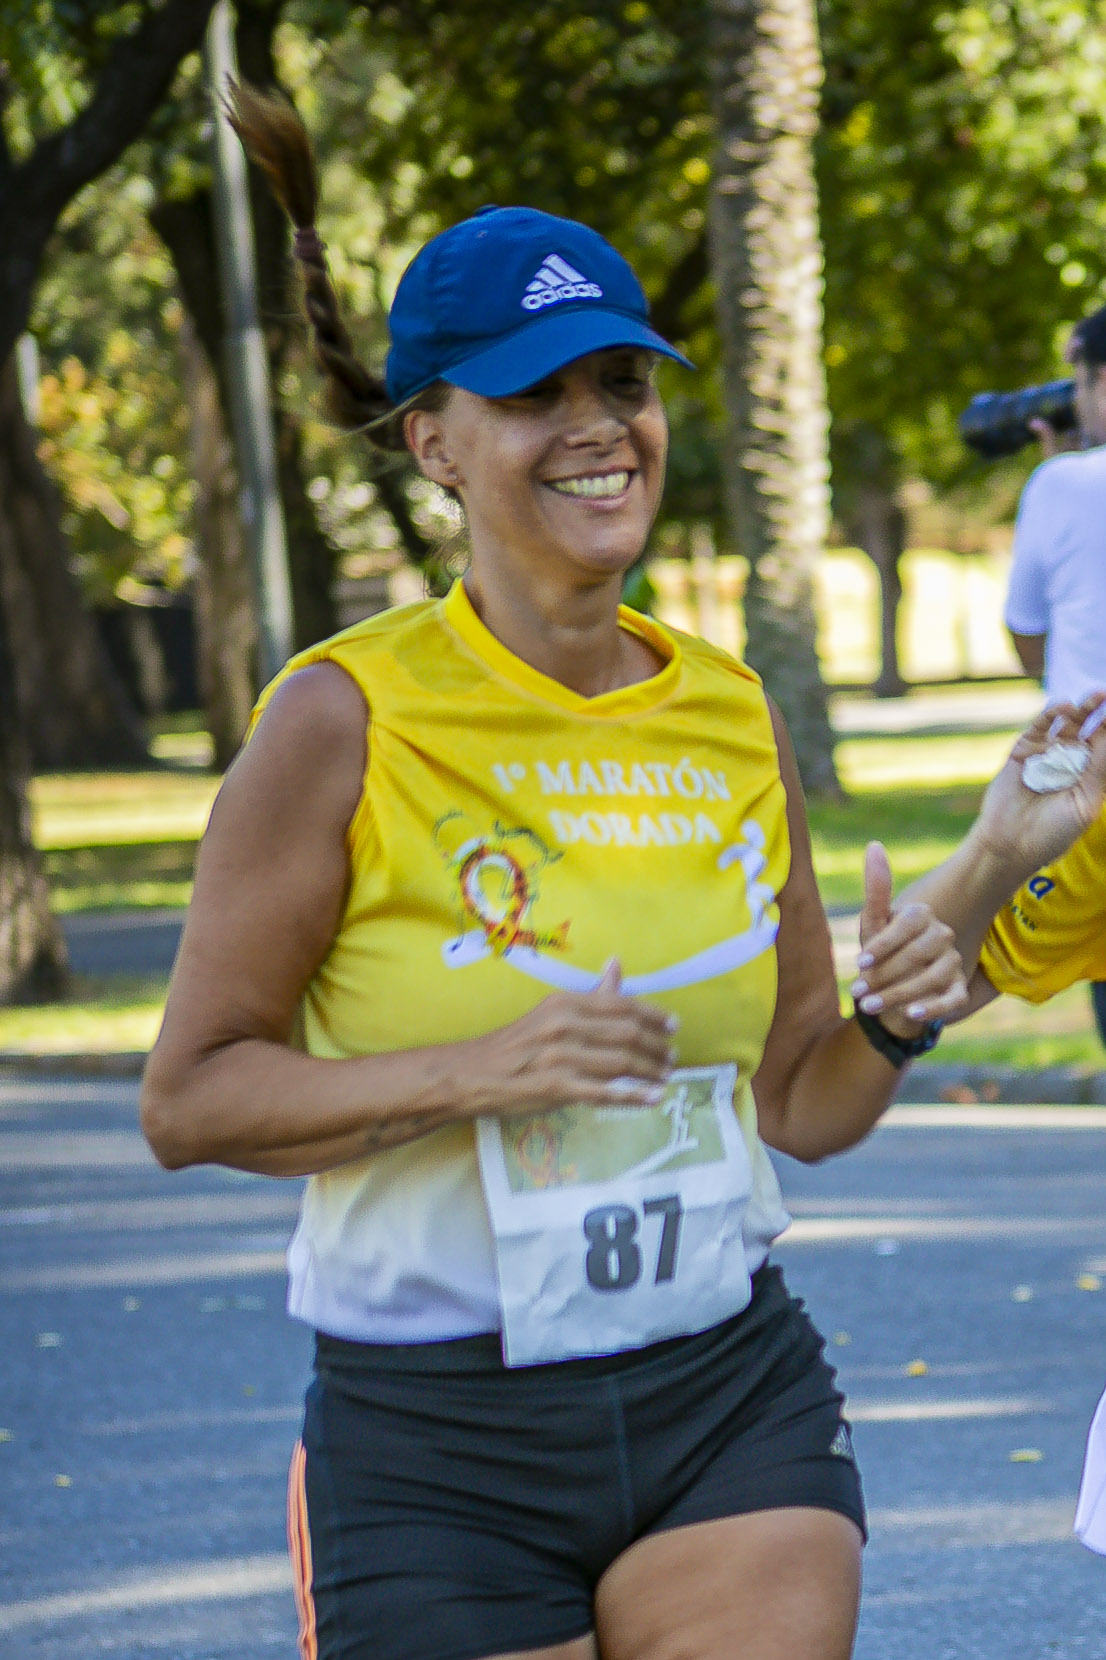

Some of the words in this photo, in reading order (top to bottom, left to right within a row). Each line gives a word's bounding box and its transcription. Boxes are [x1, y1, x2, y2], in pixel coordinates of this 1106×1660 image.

[520, 282, 603, 310] adidas
[535, 756, 731, 801] MARATÓN
[548, 810, 720, 847] DORADA
[583, 1192, 685, 1294] 87
